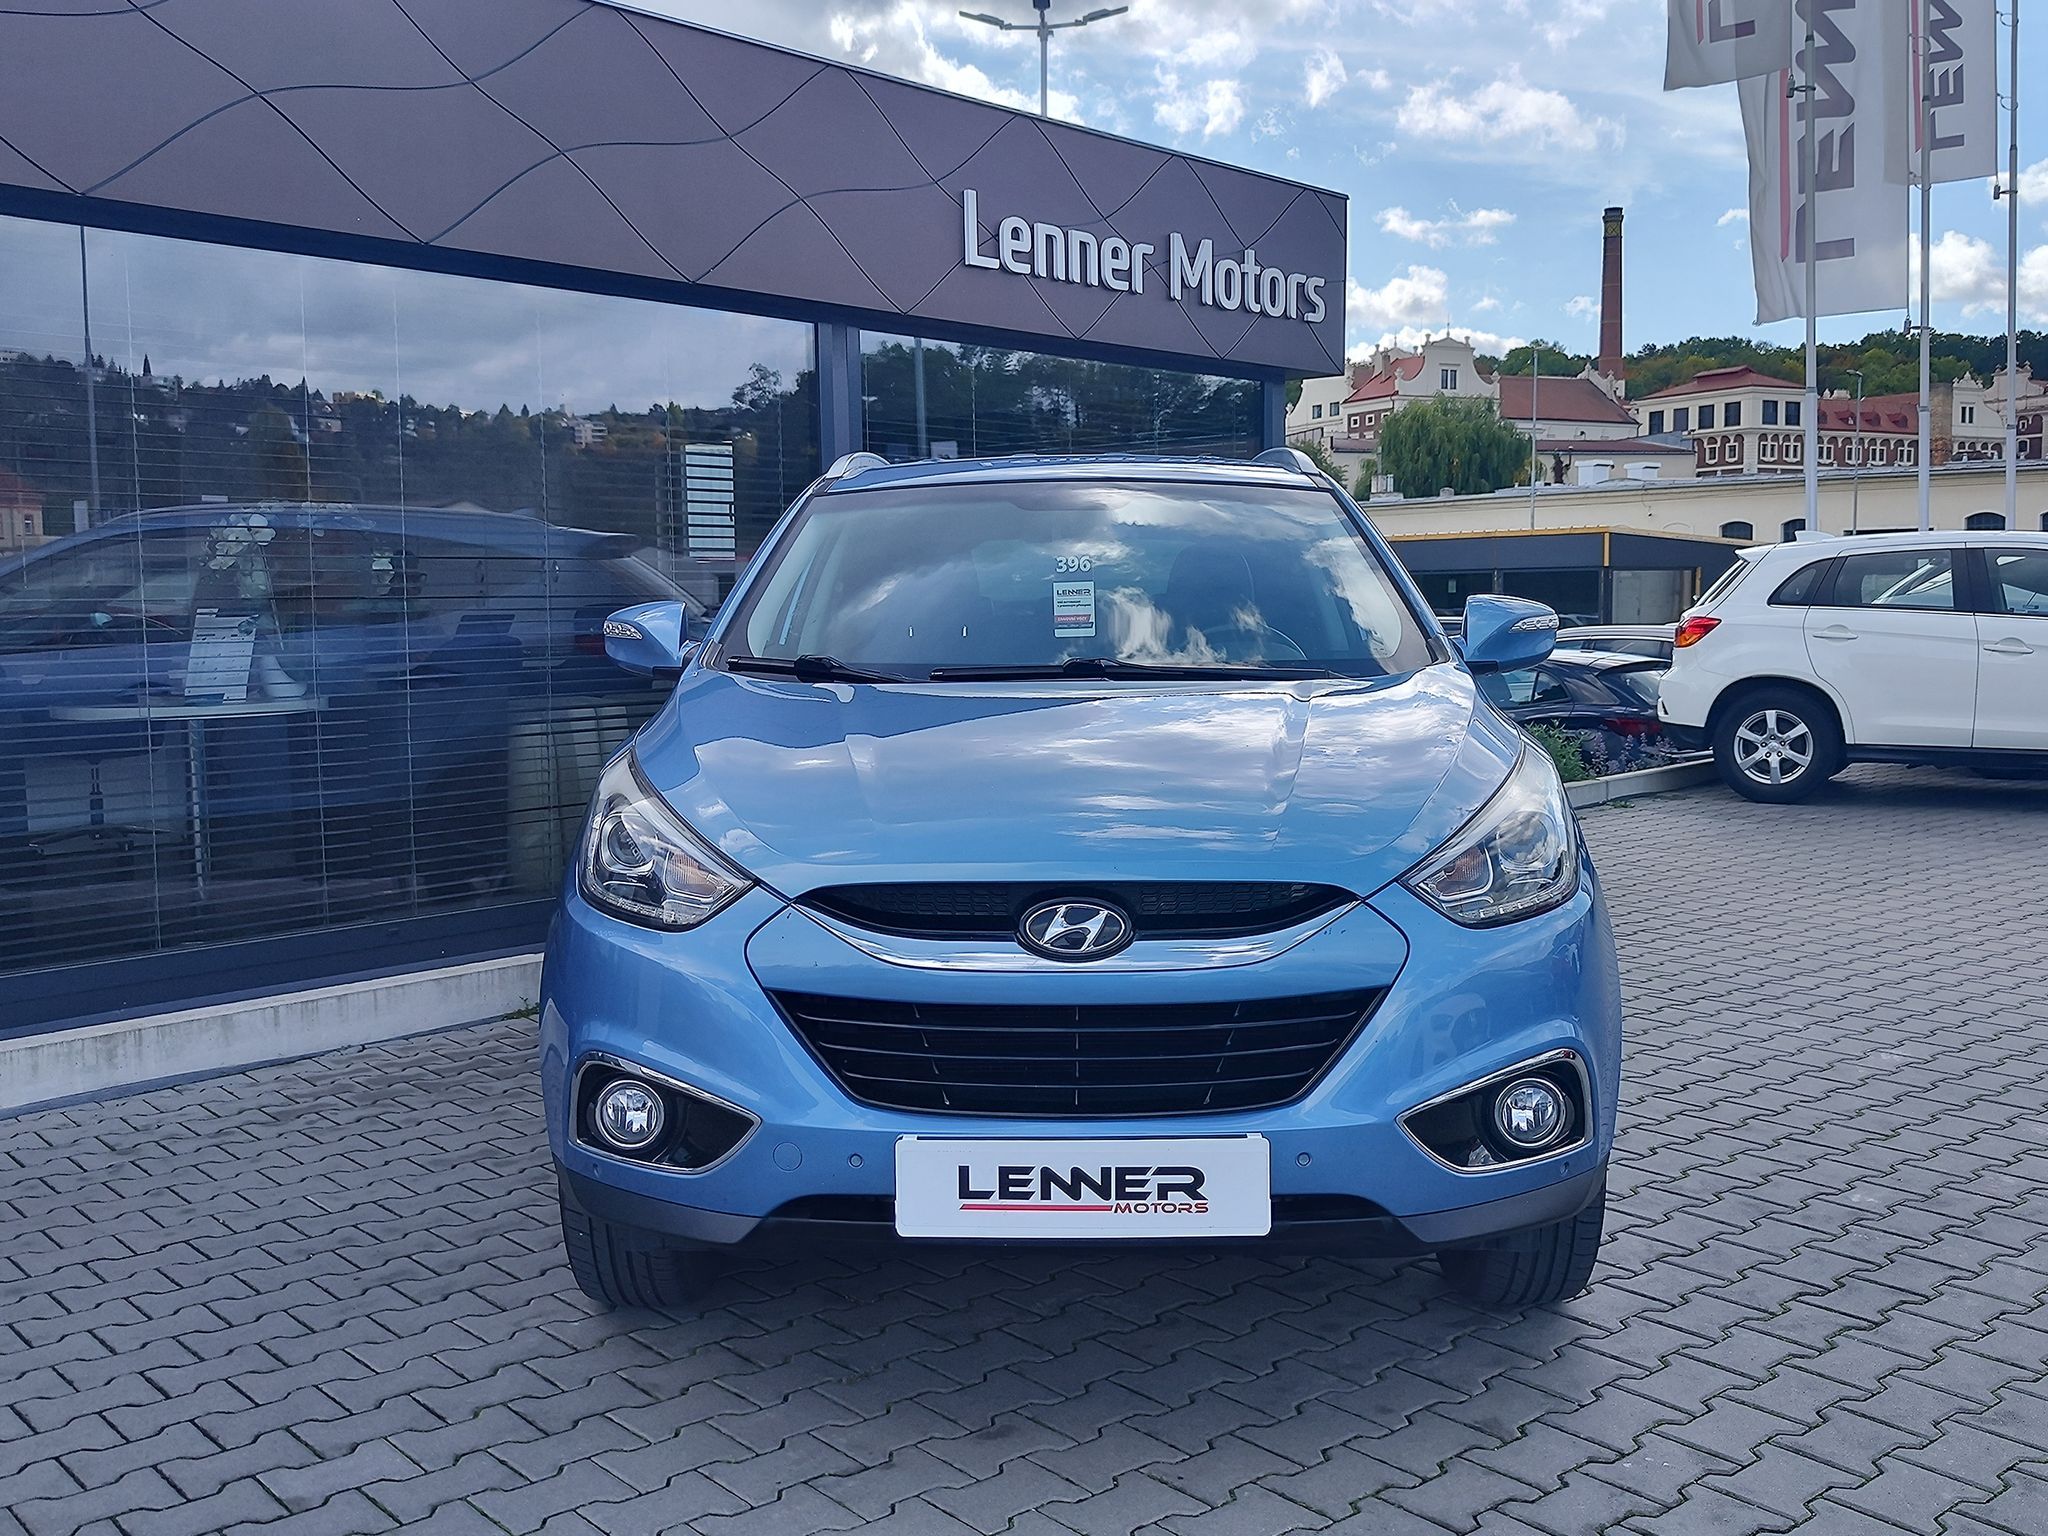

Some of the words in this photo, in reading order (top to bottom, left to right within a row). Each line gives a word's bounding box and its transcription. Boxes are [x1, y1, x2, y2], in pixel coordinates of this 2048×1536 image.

[963, 189, 1154, 294] Lenner
[1169, 232, 1325, 323] Motors
[1055, 555, 1092, 573] 396
[1056, 588, 1091, 596] LENNER
[957, 1165, 1209, 1201] LENNER
[1113, 1202, 1209, 1214] MOTORS
